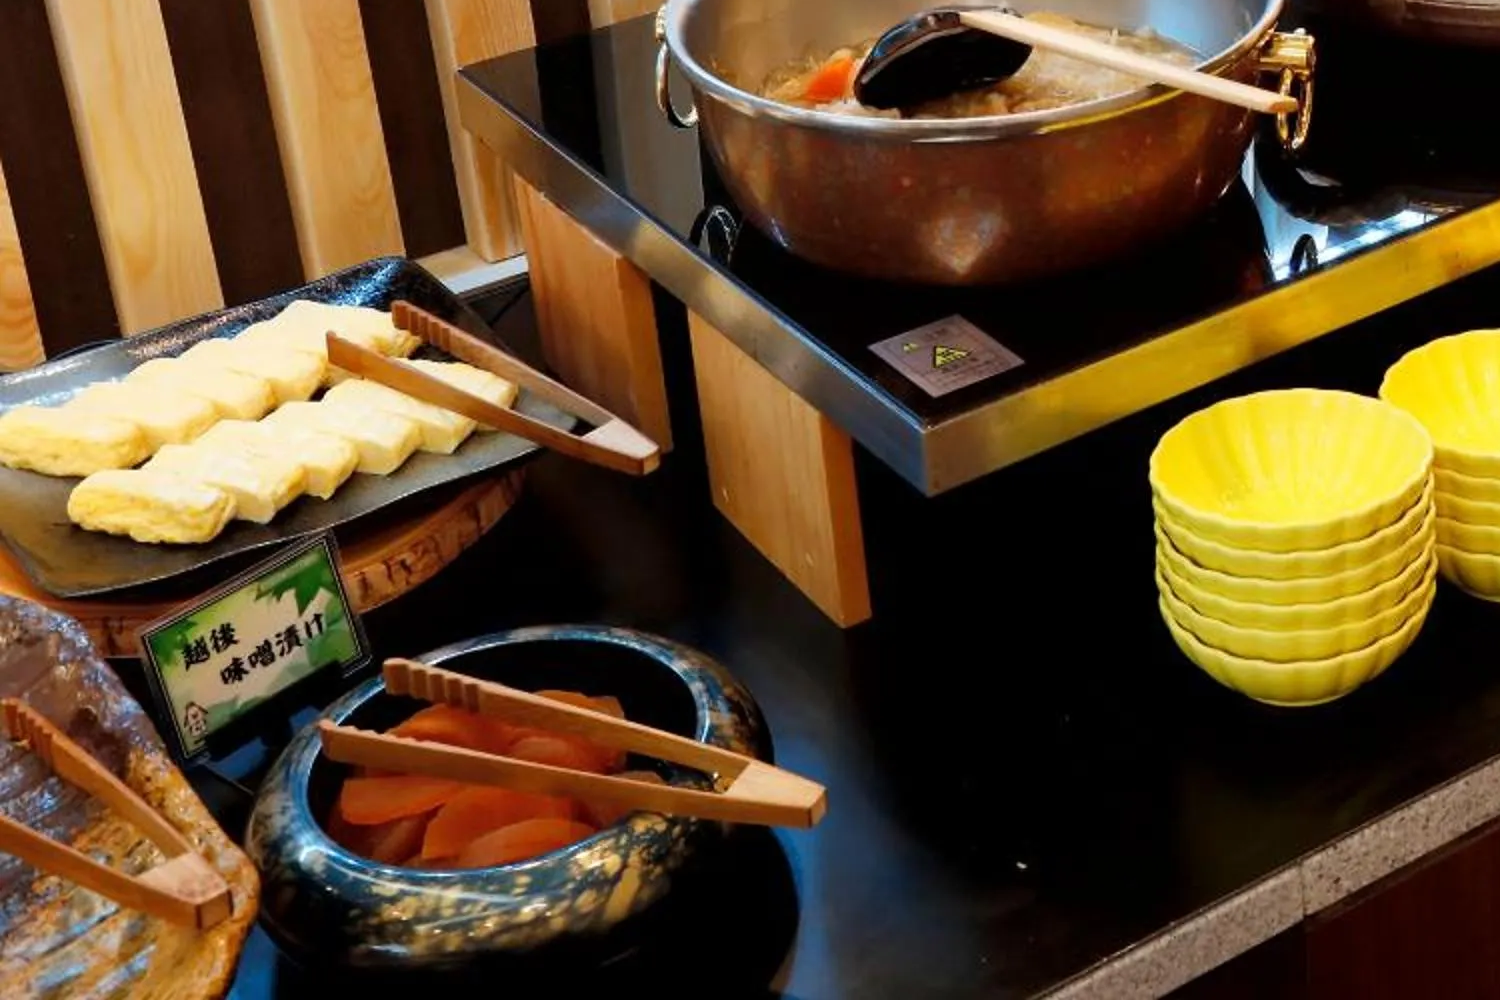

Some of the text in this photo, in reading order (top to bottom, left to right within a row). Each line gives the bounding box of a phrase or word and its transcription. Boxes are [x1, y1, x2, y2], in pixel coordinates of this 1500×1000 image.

[181, 621, 240, 671] 越後
[219, 613, 327, 686] 味噌漬け
